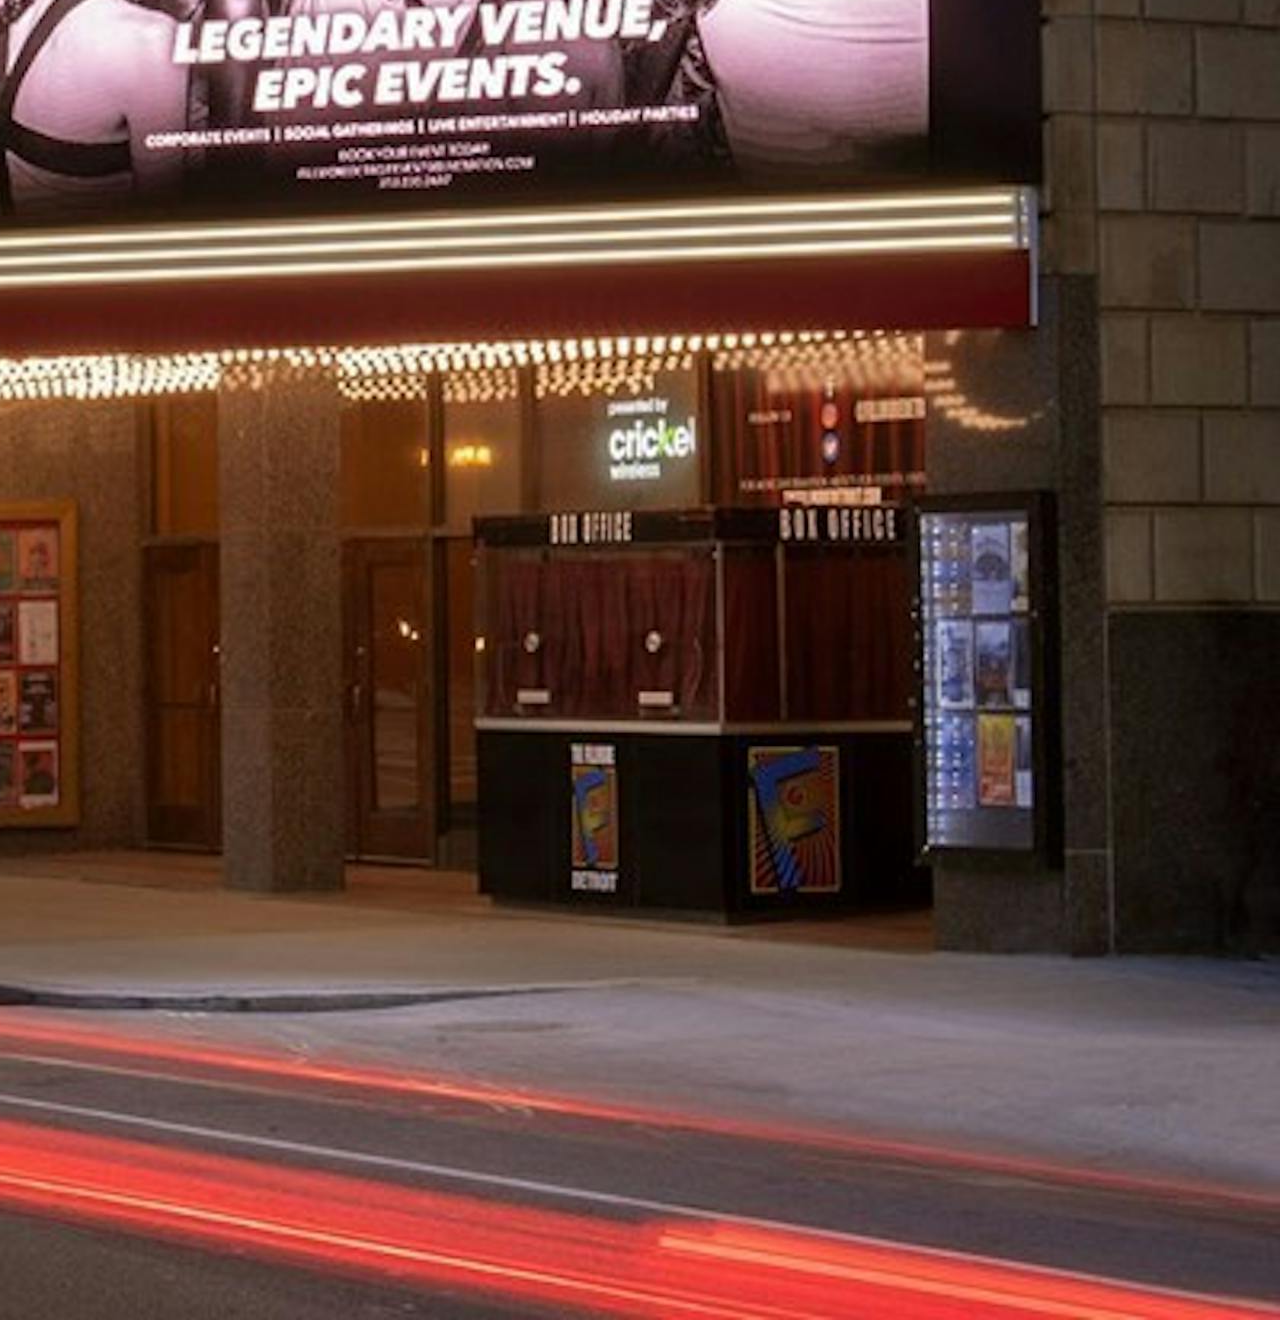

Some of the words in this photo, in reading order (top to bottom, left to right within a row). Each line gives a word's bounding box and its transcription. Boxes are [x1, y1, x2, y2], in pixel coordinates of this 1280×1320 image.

[172, 5, 471, 65] LEGENDARY
[253, 66, 367, 112] EPIC
[374, 51, 583, 105] EVENTS.
[223, 127, 271, 144] EVENTS
[779, 508, 818, 541] BOX
[827, 508, 896, 541] OFFICE
